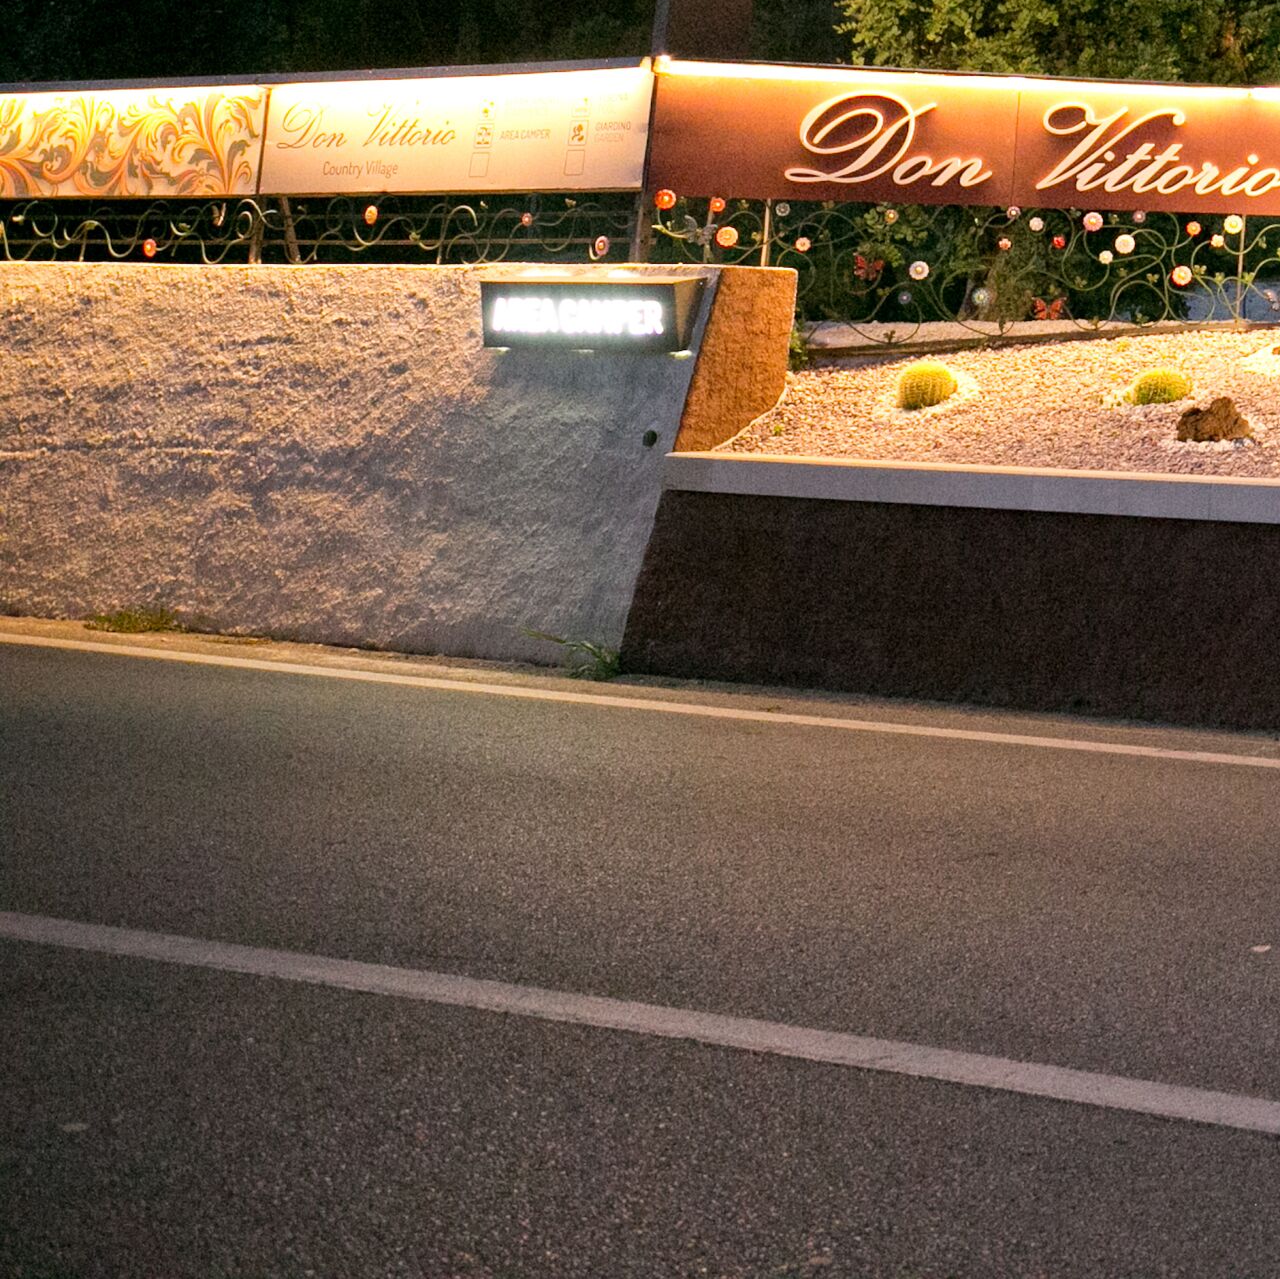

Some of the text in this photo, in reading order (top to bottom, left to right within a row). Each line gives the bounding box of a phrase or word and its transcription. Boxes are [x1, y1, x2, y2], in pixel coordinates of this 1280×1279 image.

[276, 99, 457, 150] Don Vittorio
[499, 128, 551, 140] AREA CAMPER
[784, 90, 993, 188] Don
[323, 160, 399, 179] Country Village
